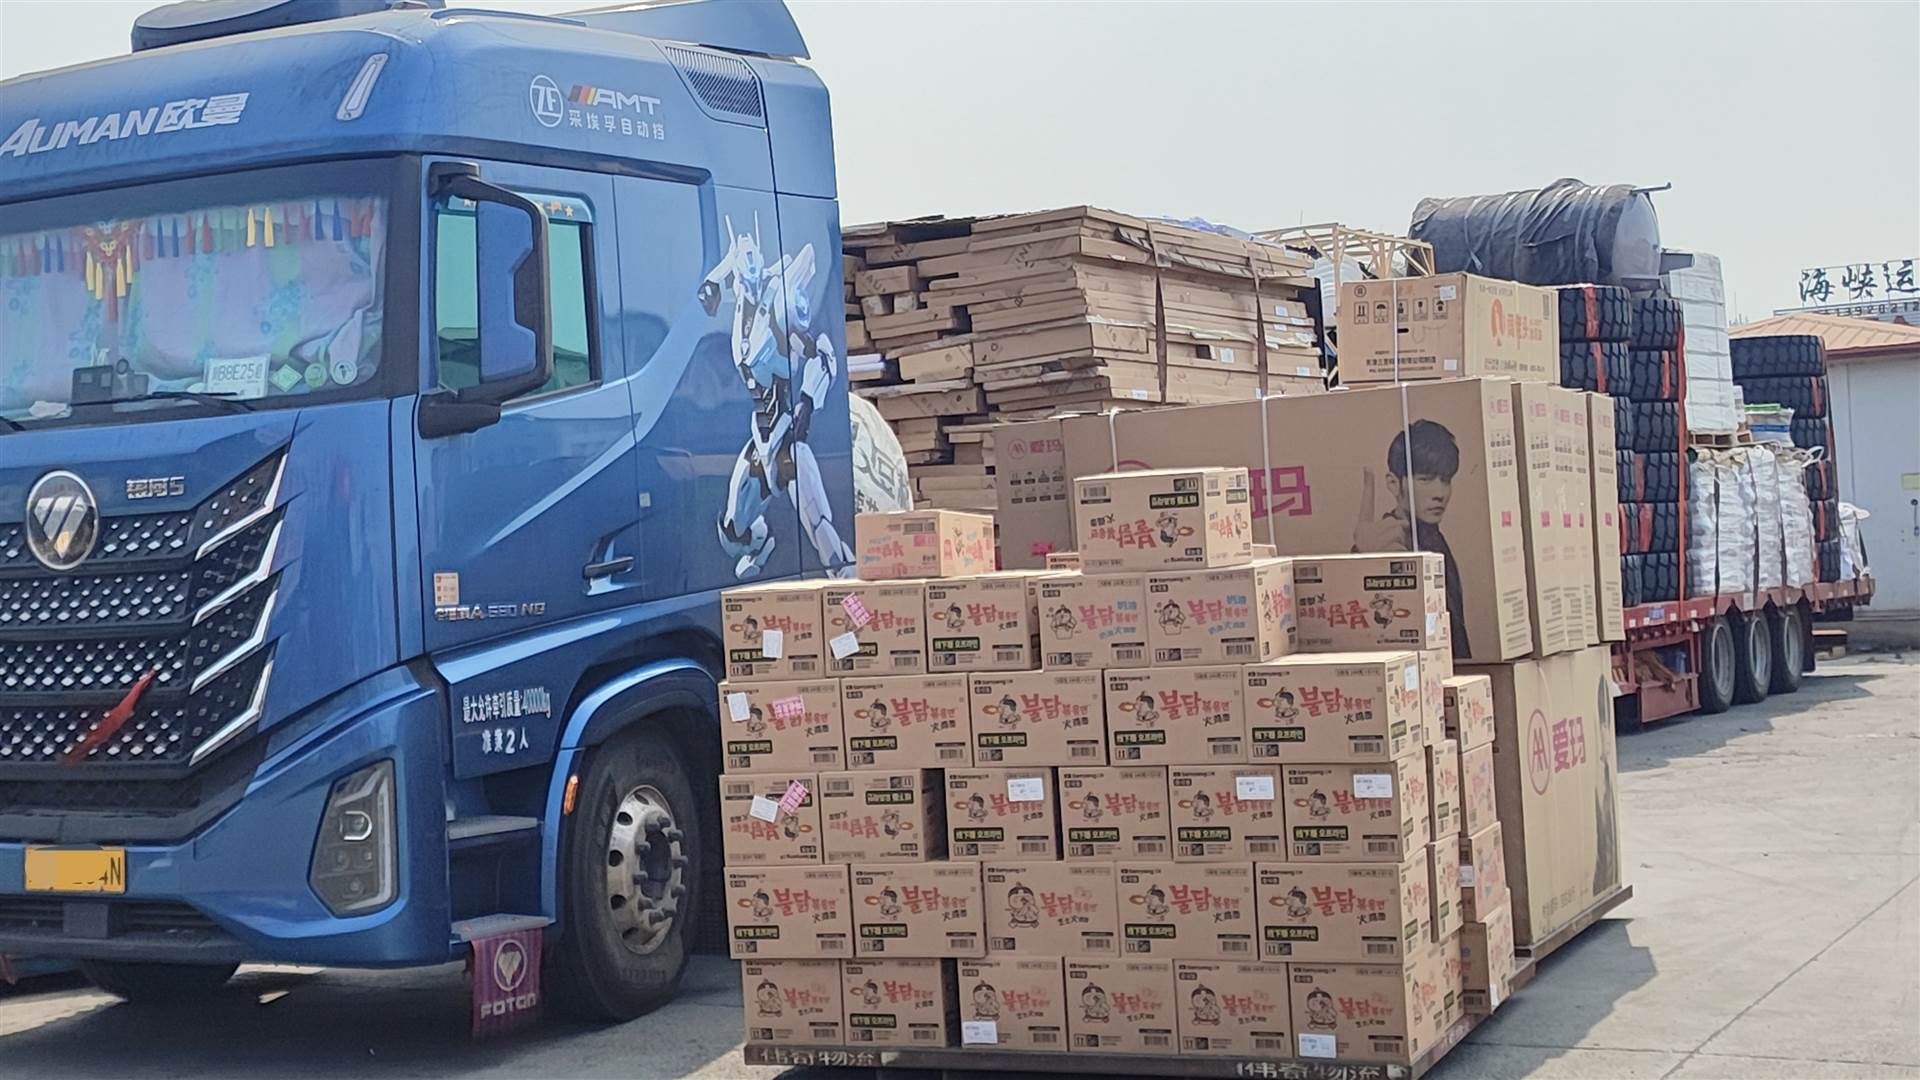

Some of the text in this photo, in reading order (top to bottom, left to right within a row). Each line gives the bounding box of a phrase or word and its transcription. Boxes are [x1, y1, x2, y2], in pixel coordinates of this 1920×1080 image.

[593, 88, 661, 115] AMT
[1799, 259, 1920, 302] 海峡运
[1552, 716, 1586, 774] 爱玛
[480, 993, 537, 1020] FOTON
